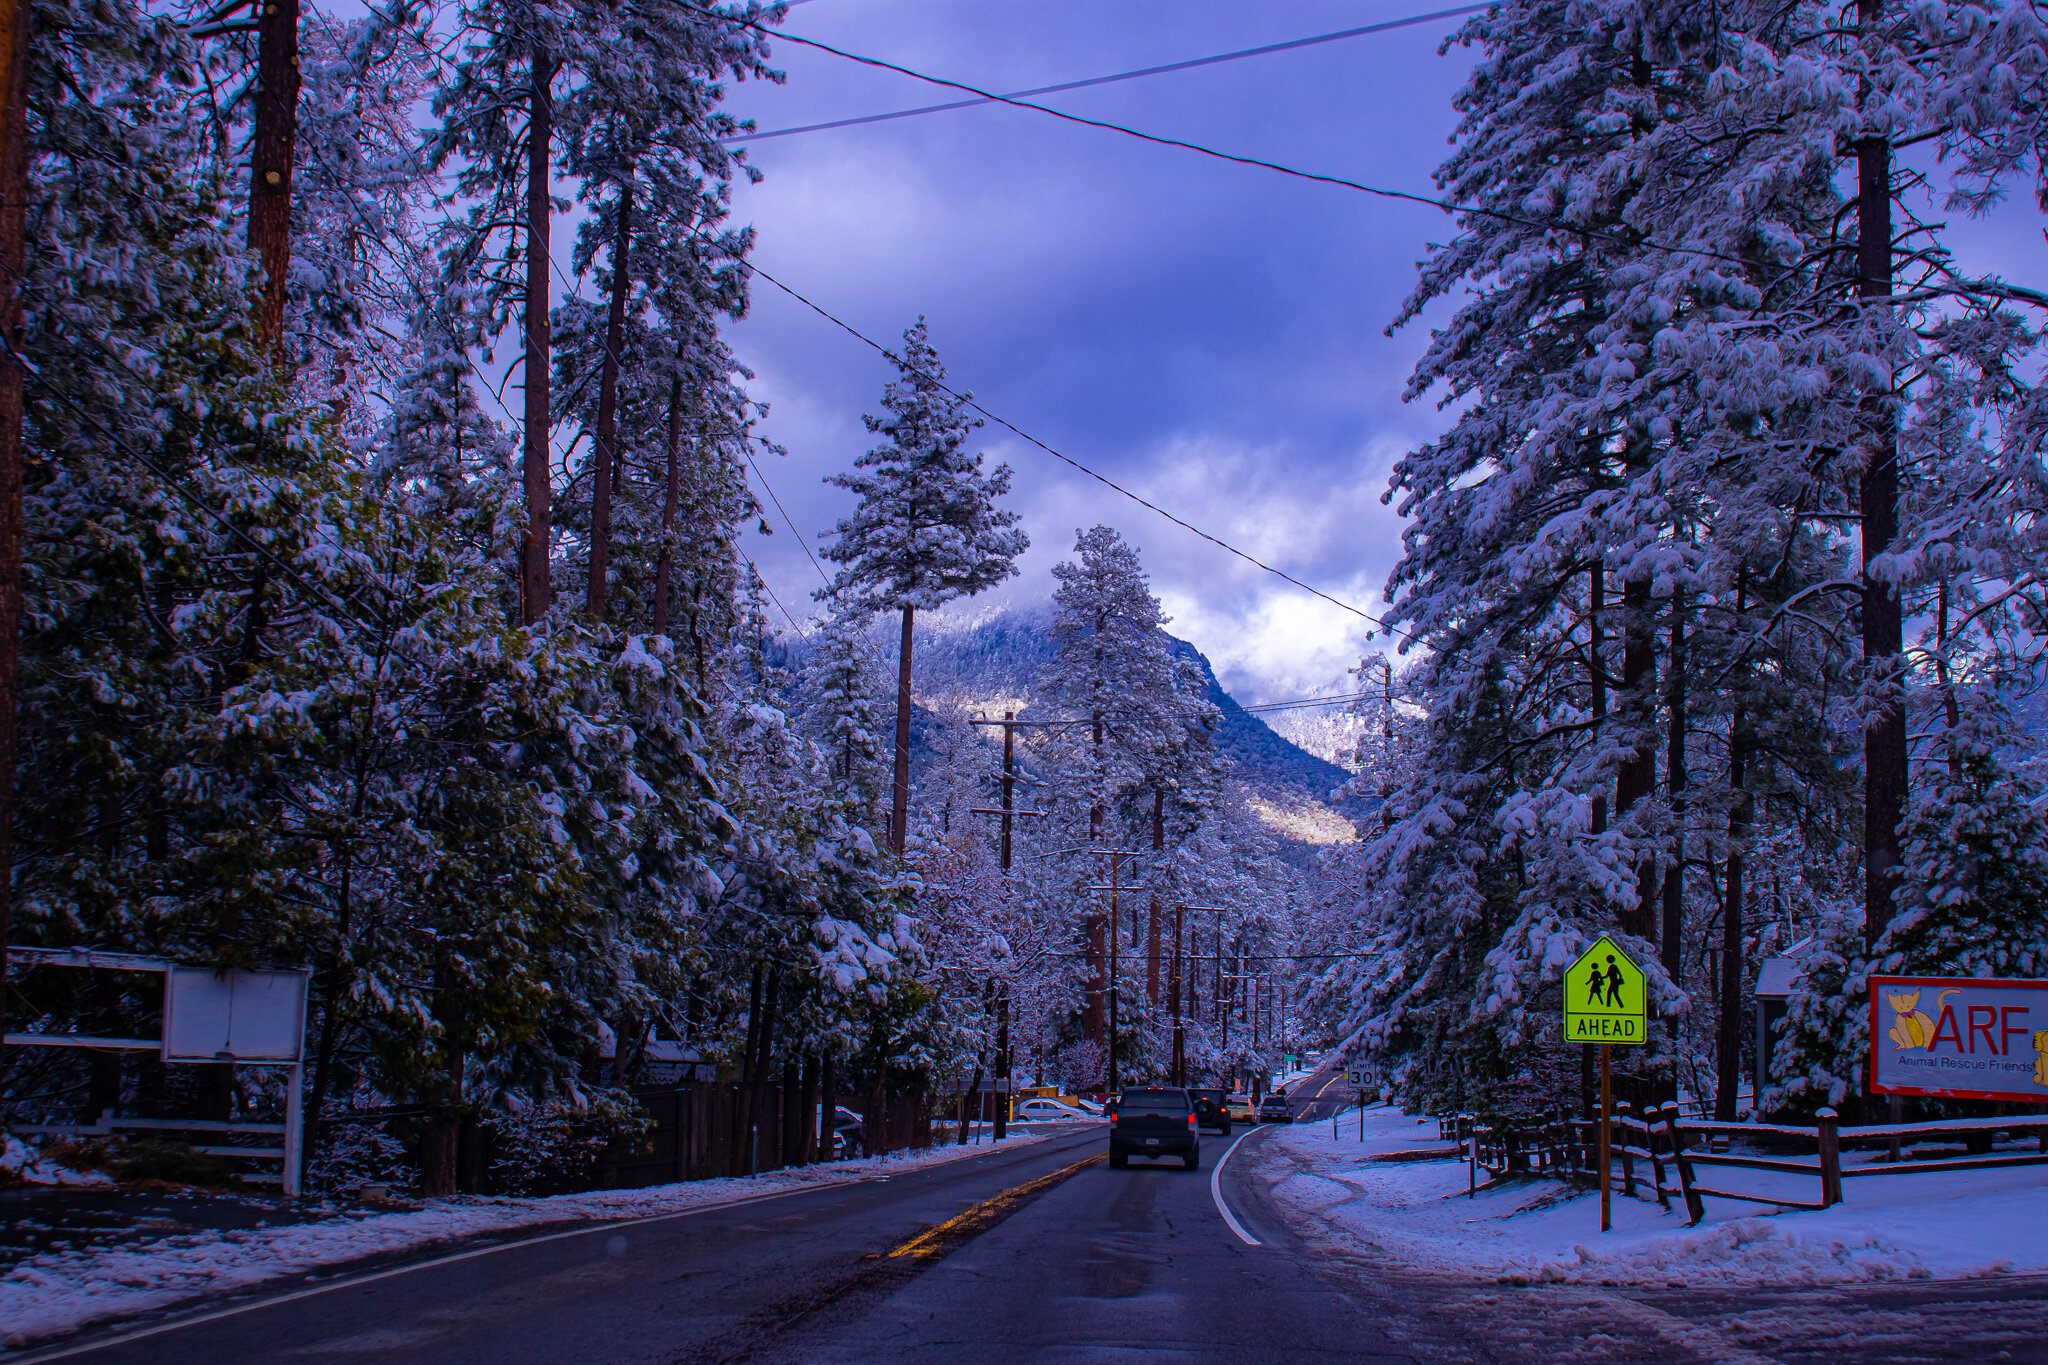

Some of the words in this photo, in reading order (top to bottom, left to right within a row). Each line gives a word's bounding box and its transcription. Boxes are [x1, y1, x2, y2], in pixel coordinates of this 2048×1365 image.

[1577, 1019, 1635, 1036] AHEAD
[1927, 1004, 2029, 1055] ARF
[1898, 1055, 1937, 1067] Animal
[1941, 1057, 1986, 1070] Rescue
[1989, 1060, 2033, 1072] Friends
[1351, 1070, 1372, 1084] 30
